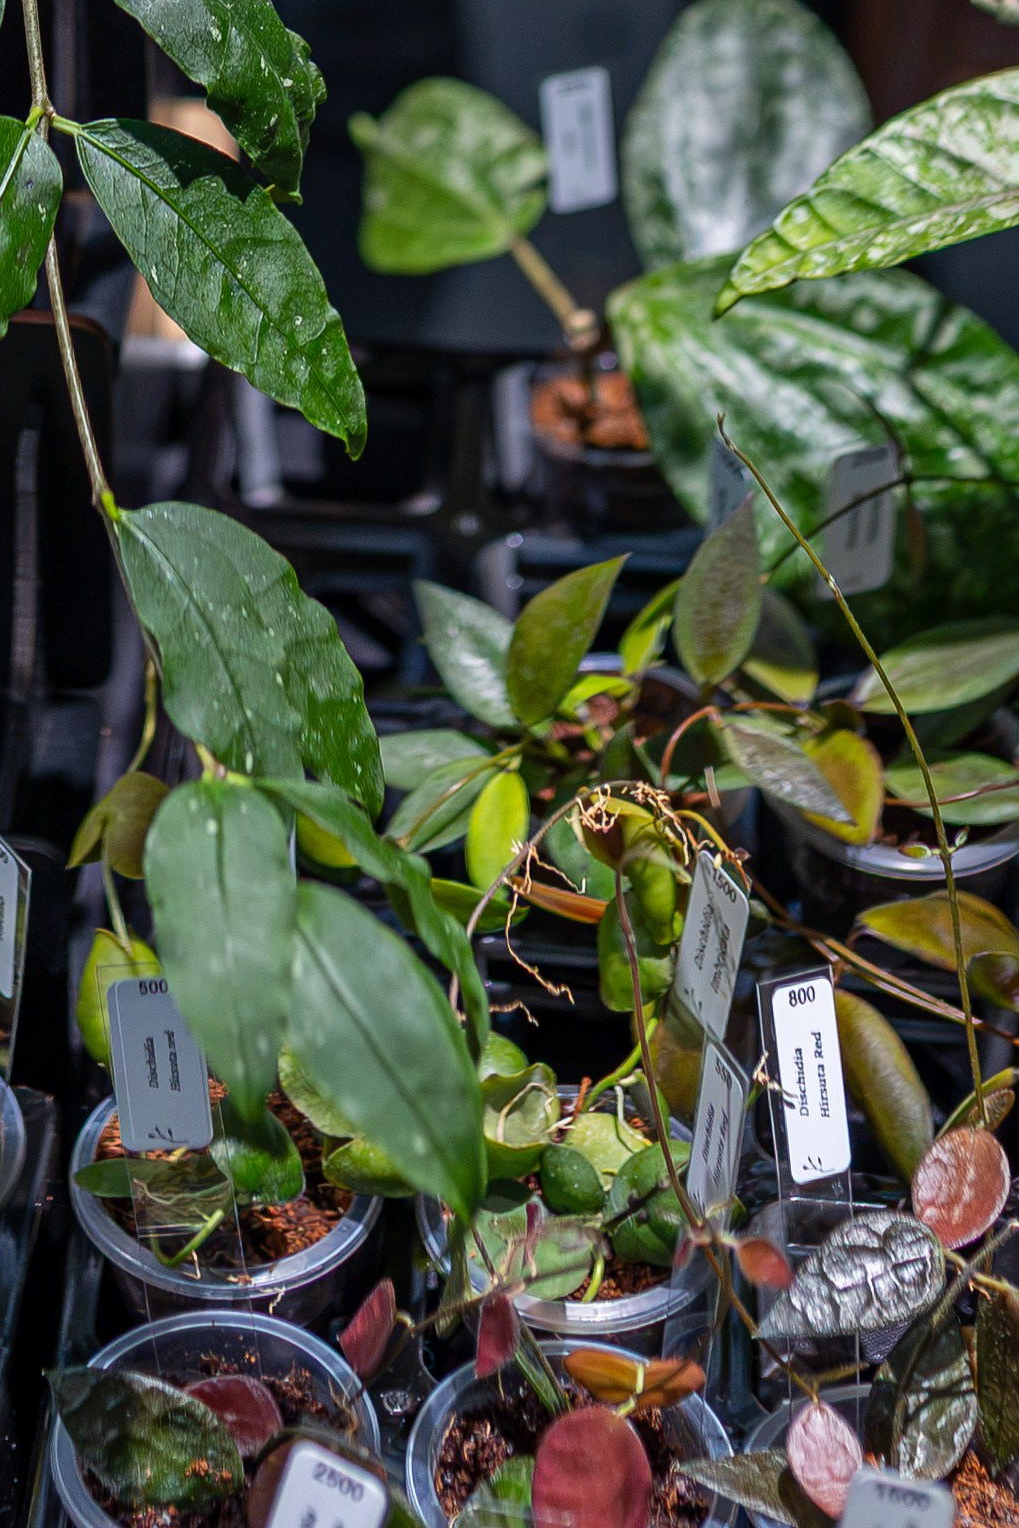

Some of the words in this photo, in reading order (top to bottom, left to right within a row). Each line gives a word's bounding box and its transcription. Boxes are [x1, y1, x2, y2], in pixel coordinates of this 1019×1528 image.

[711, 868, 737, 904] 1500
[788, 986, 816, 1008] 800
[811, 1032, 824, 1060] Red
[793, 1048, 810, 1117] Dischidia
[816, 1064, 831, 1118] Hirsuta
